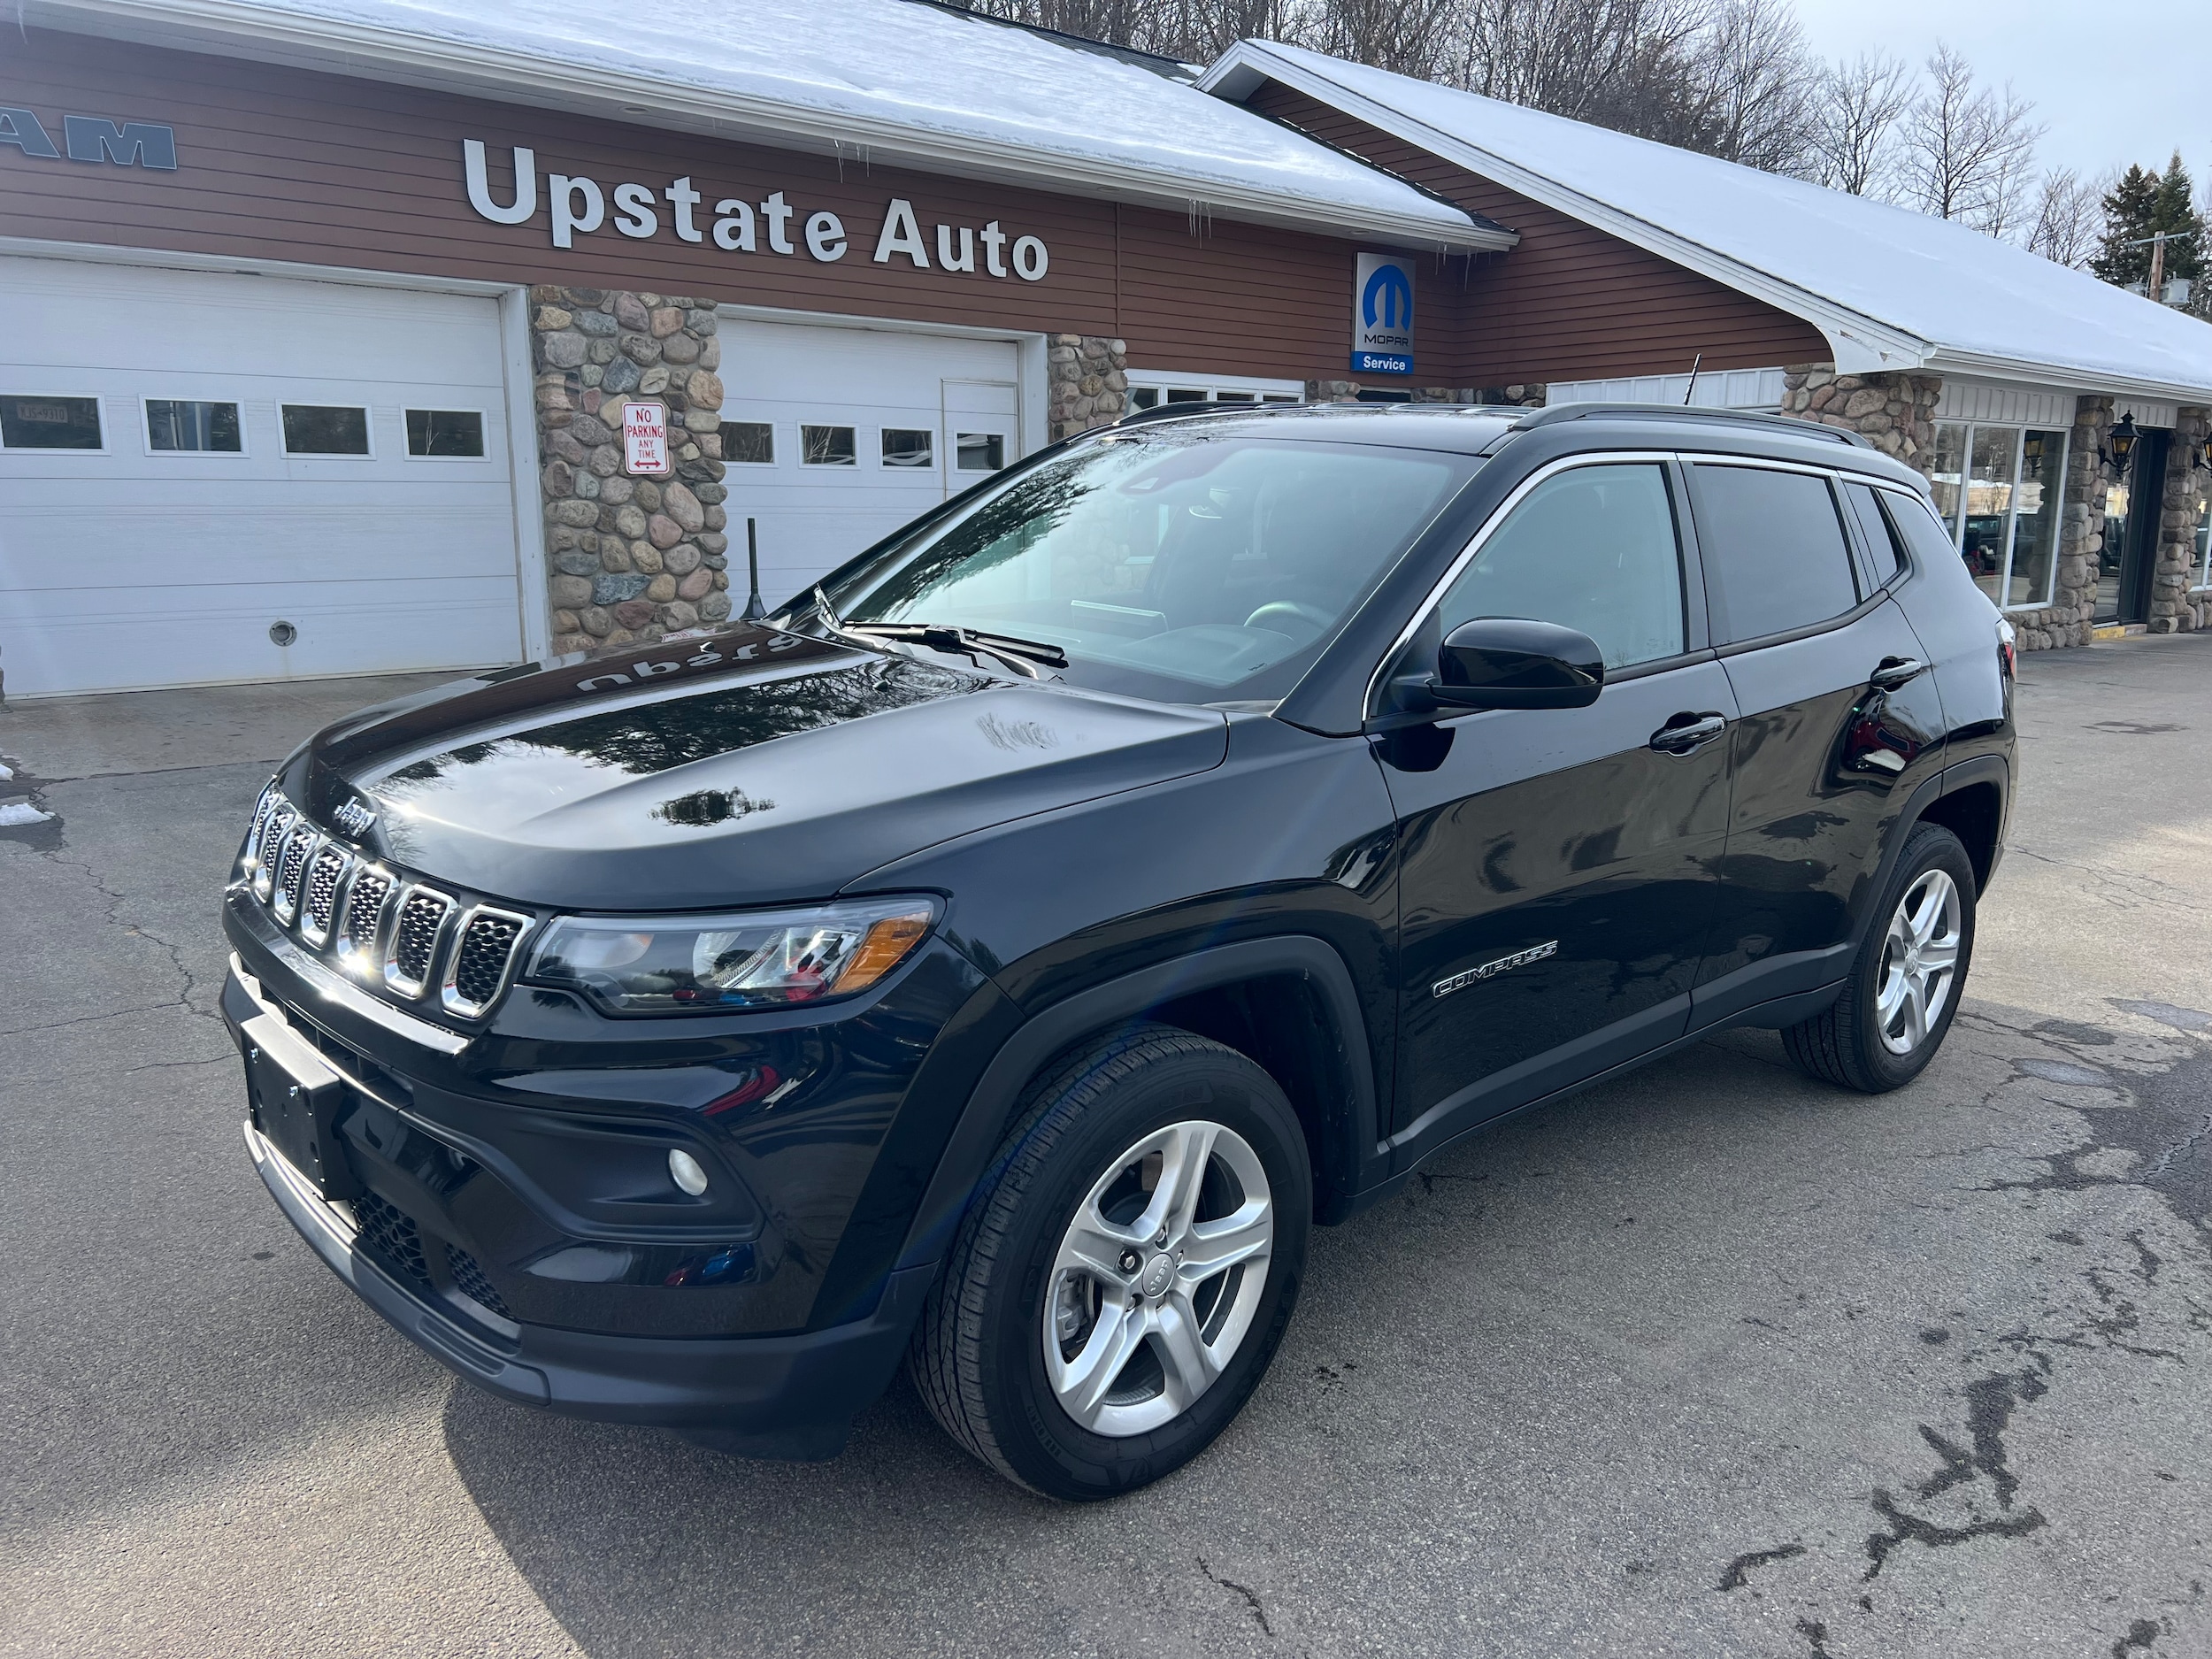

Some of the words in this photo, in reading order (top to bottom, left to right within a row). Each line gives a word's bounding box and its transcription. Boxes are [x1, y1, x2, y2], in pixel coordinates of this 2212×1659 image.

[463, 138, 848, 263] Upstate
[873, 197, 1049, 282] Auto
[1364, 334, 1409, 347] MOPAR
[1363, 355, 1406, 371] Service
[636, 410, 652, 423] NO
[627, 425, 663, 438] PARKING
[638, 440, 654, 449] ANY
[638, 449, 656, 458] TIME
[333, 795, 377, 838] Jeep
[1432, 940, 1559, 998] COMPASS
[1150, 1259, 1168, 1292] Jeep
